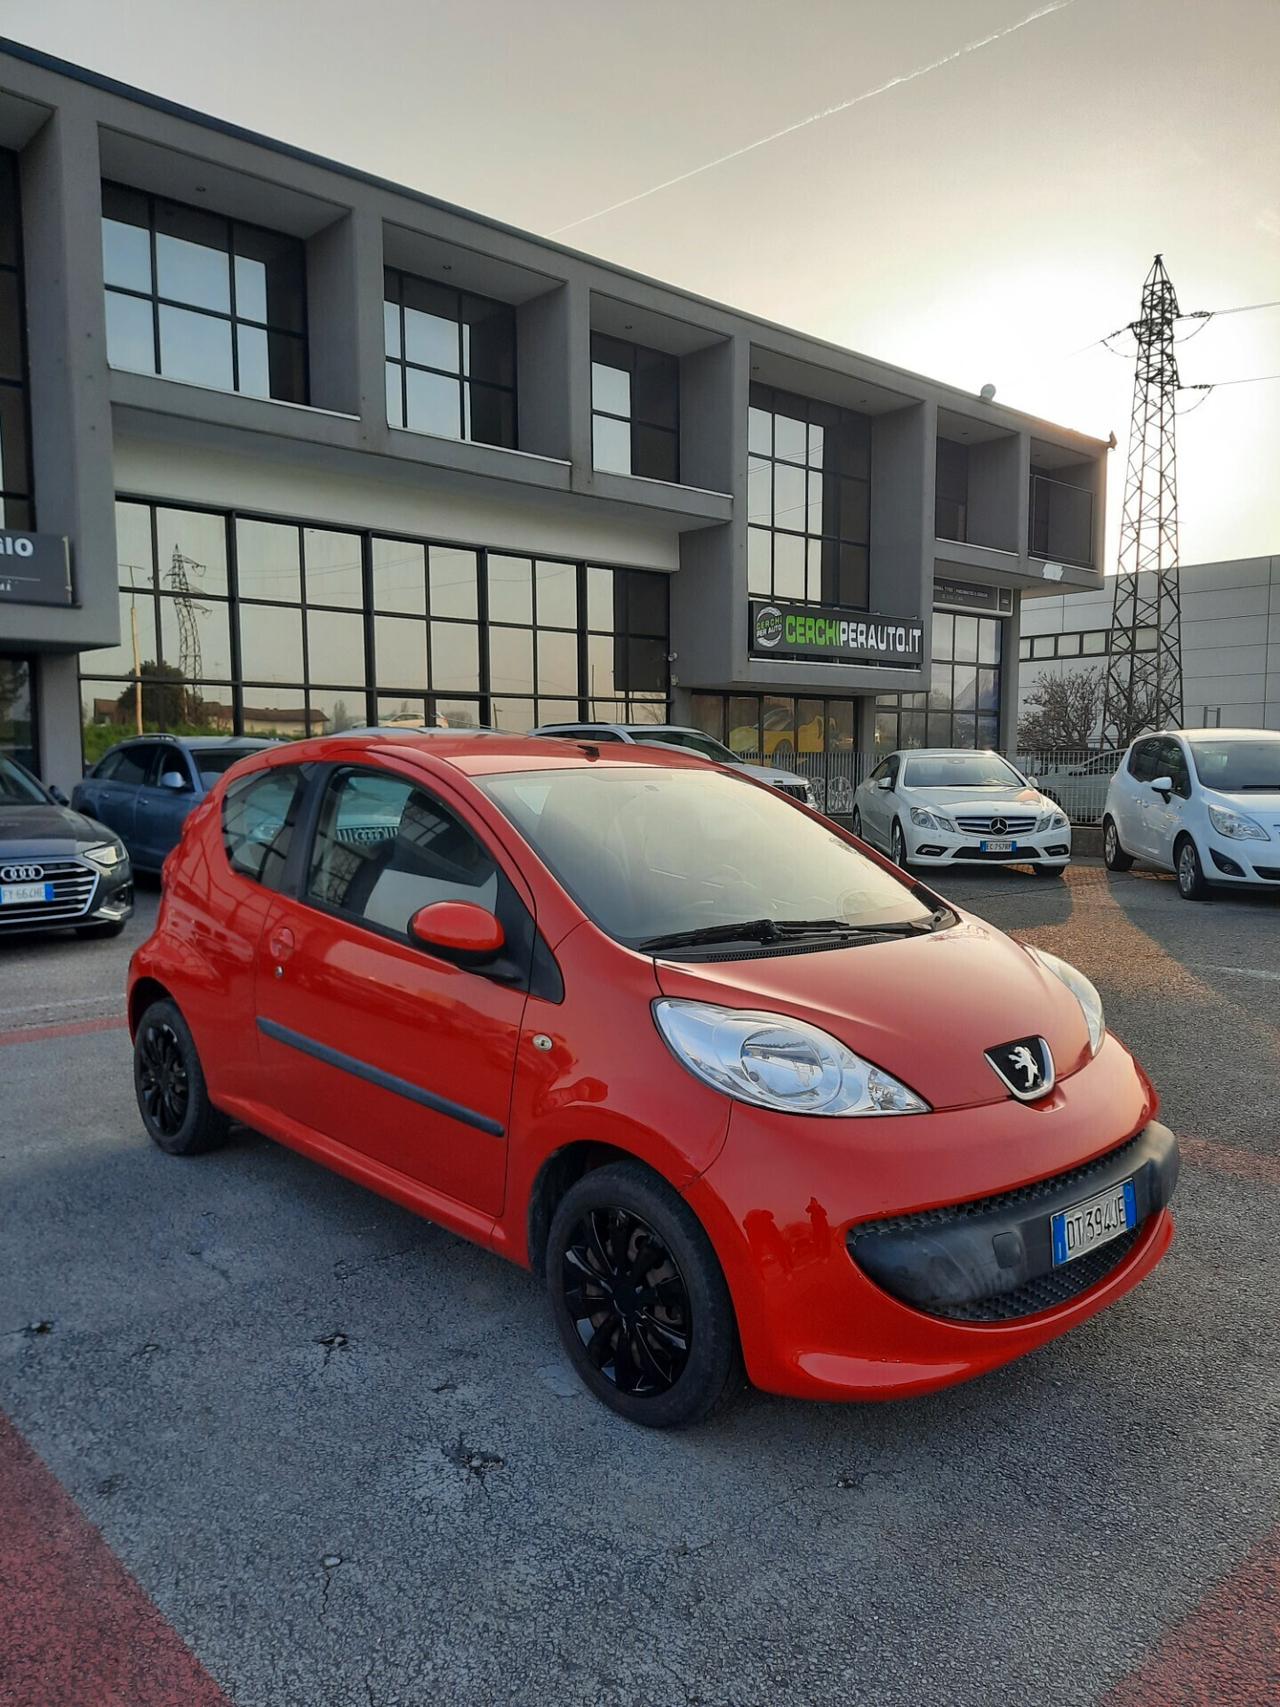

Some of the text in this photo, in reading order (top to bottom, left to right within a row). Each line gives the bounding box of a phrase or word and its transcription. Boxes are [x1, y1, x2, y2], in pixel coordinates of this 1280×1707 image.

[756, 616, 783, 630] CERCHI
[767, 624, 783, 635] AUTO
[785, 615, 922, 653] CERCHIPERAUTO.IT
